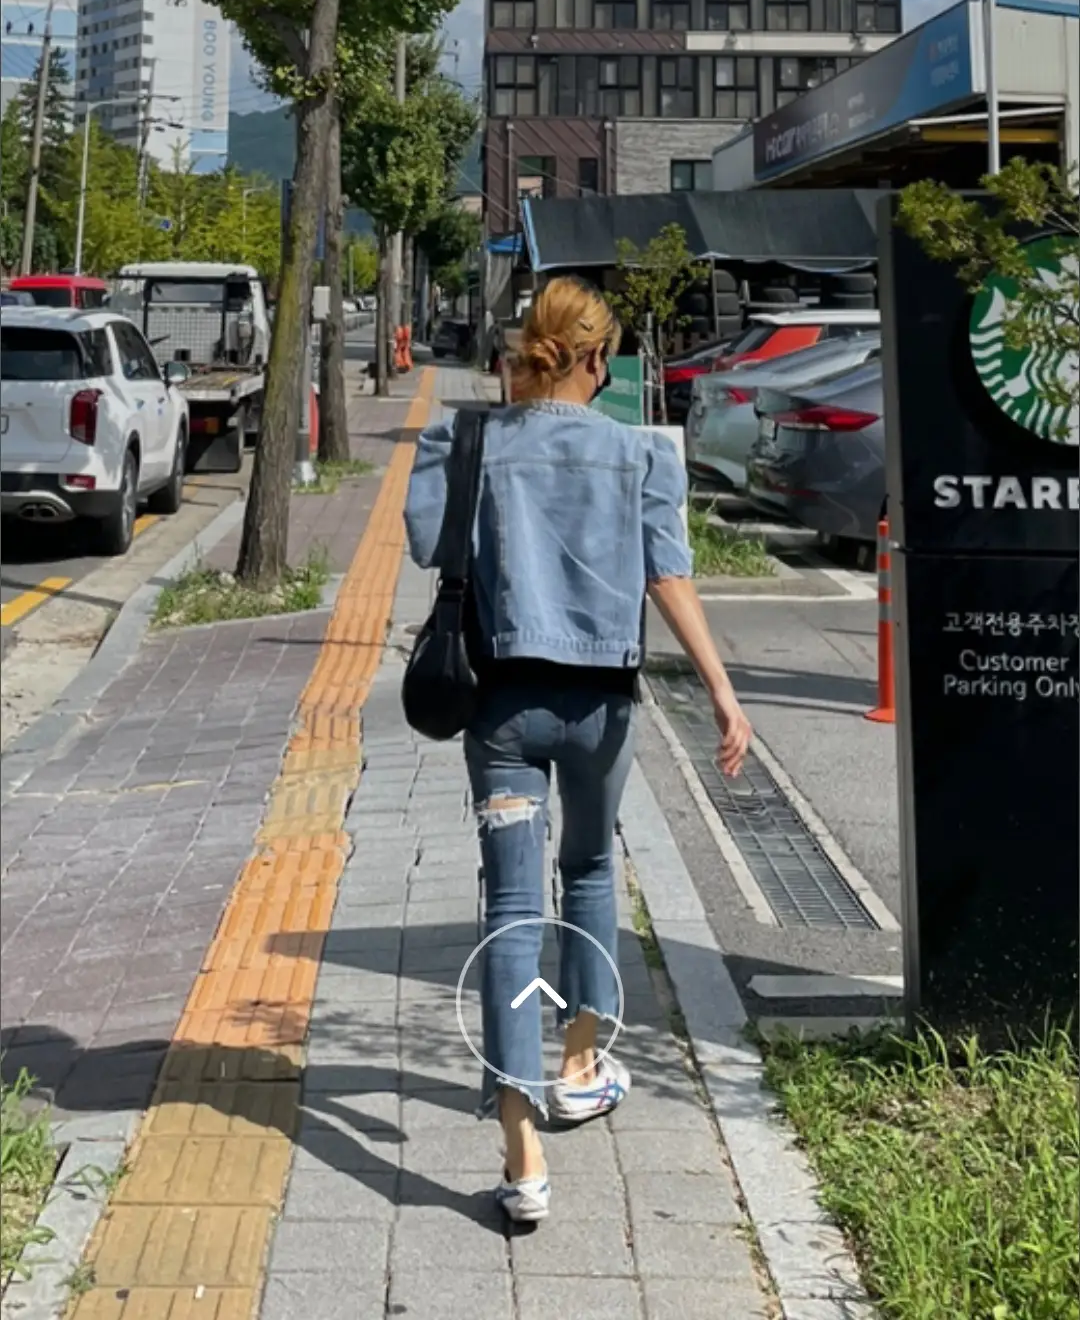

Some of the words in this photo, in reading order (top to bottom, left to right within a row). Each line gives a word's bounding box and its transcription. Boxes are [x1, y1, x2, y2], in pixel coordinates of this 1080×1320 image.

[203, 20, 217, 56] BOO
[201, 63, 216, 122] YOUNG
[959, 648, 1070, 672] Customer
[943, 674, 1027, 701] Parking
